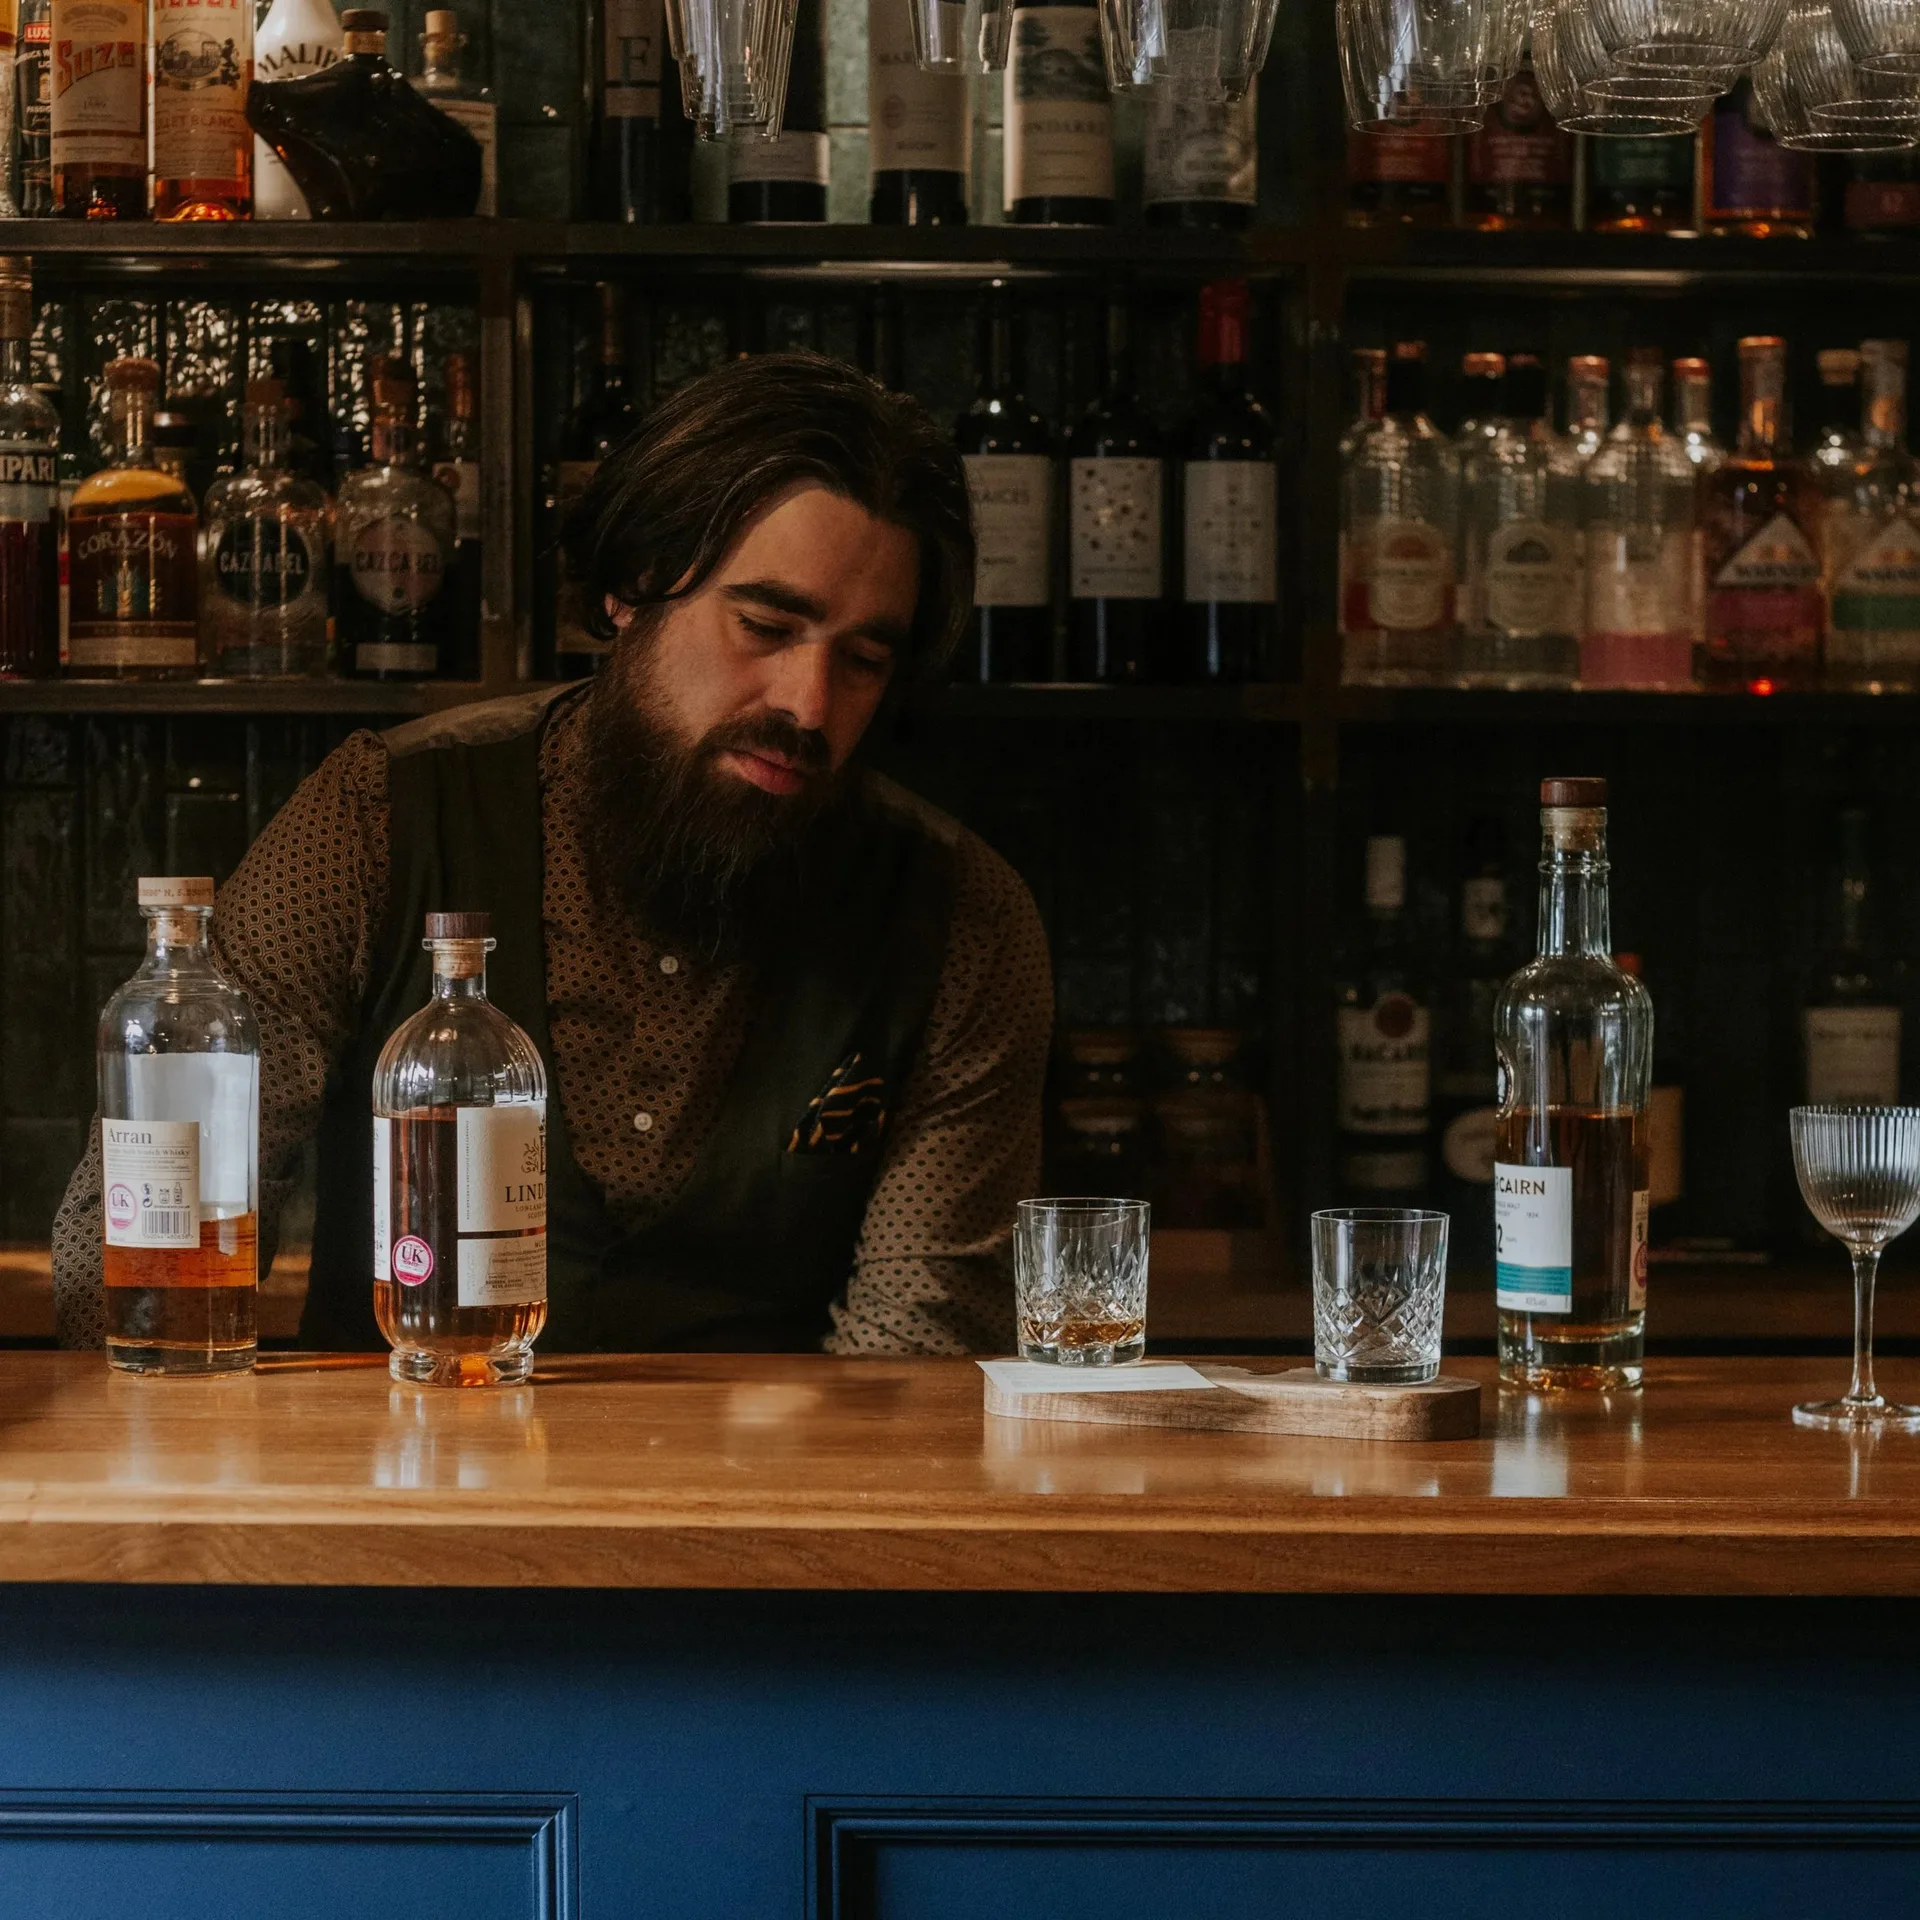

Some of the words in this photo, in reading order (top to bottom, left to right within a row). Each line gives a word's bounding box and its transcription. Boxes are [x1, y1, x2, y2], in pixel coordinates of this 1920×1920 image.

[107, 1128, 152, 1144] Arran
[162, 1149, 190, 1158] Whisky
[402, 1245, 423, 1264] UK
